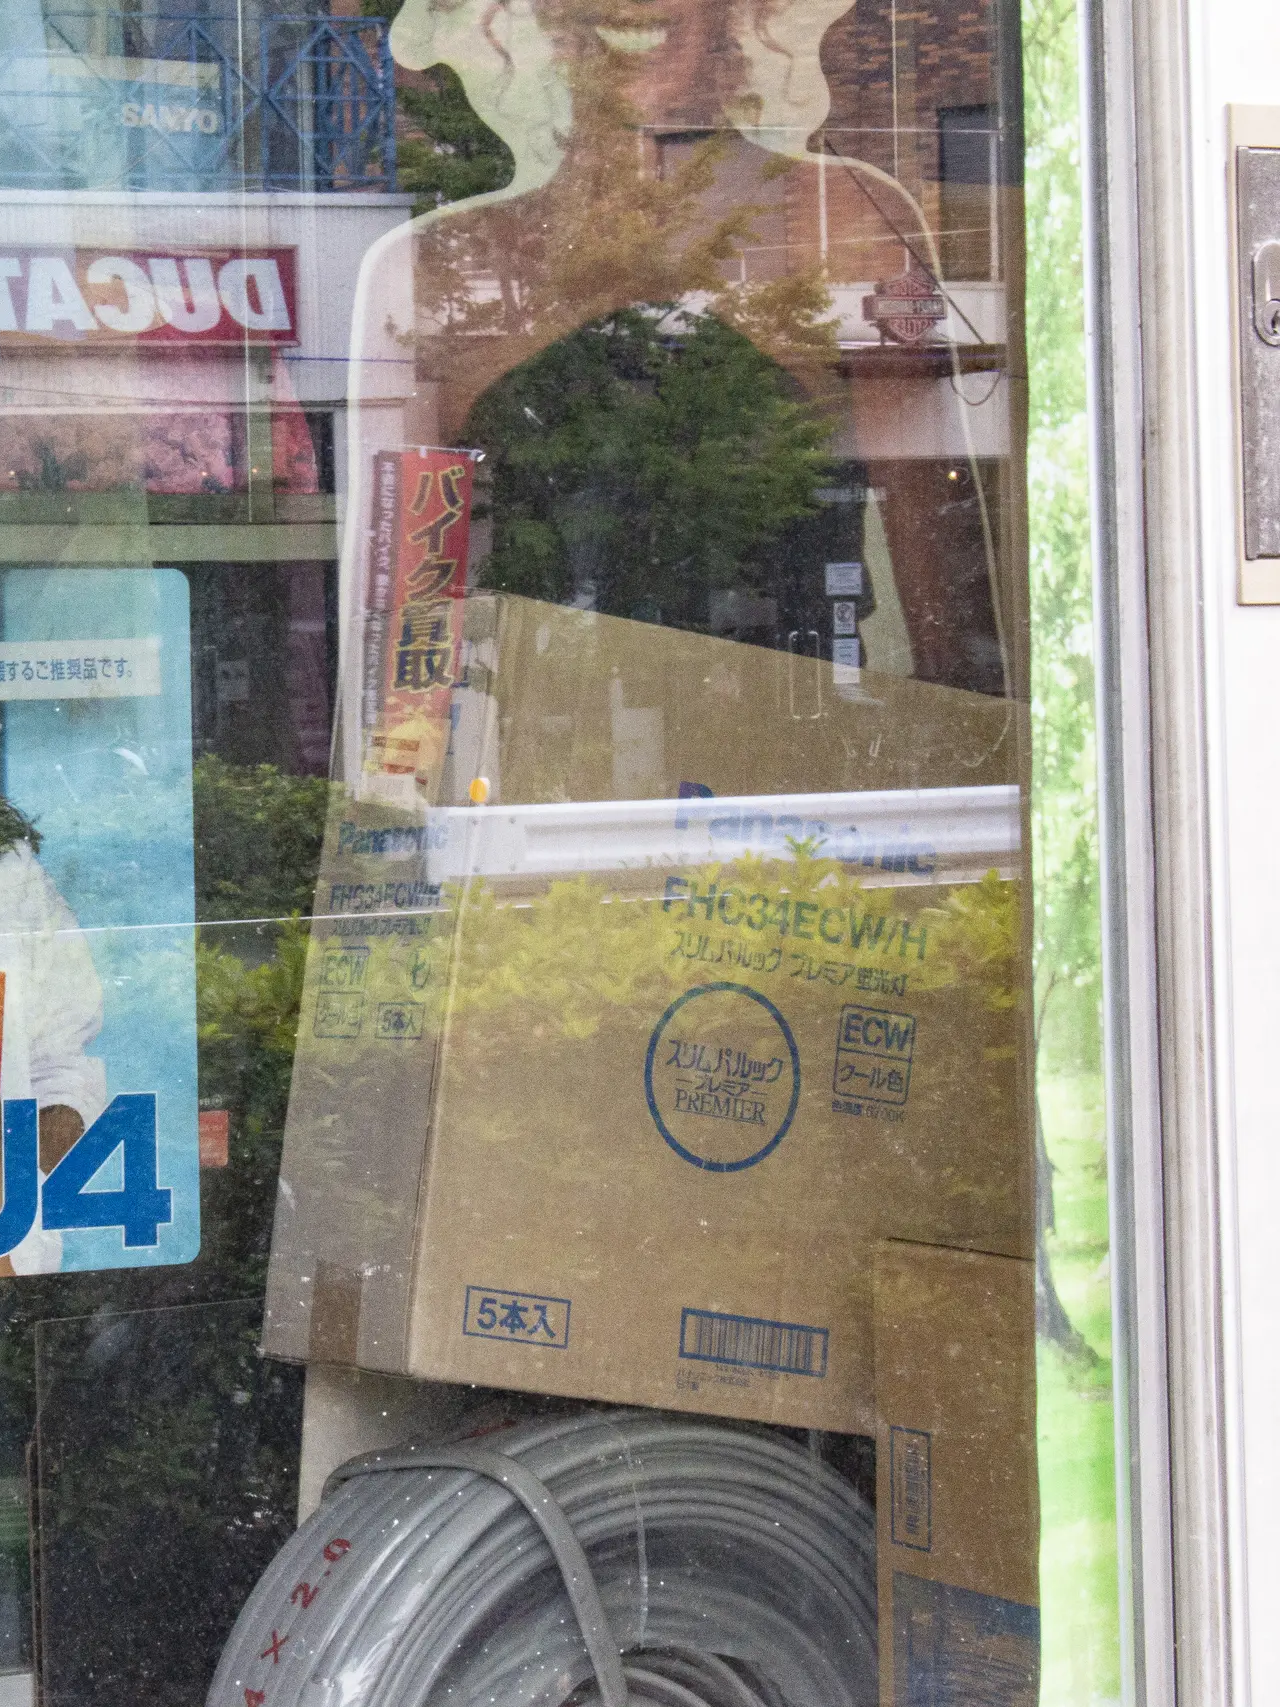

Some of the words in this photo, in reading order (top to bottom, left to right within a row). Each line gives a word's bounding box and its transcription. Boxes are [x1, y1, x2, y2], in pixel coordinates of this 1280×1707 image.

[122, 103, 218, 134] SANYO
[393, 465, 466, 694] バイク買取
[675, 780, 937, 876] Panasonic
[845, 1013, 911, 1052] ECW
[666, 1039, 784, 1083] スリムパルック
[839, 1064, 904, 1094] クール色
[674, 1087, 766, 1124] PREMIER
[476, 1296, 557, 1339] 5本入
